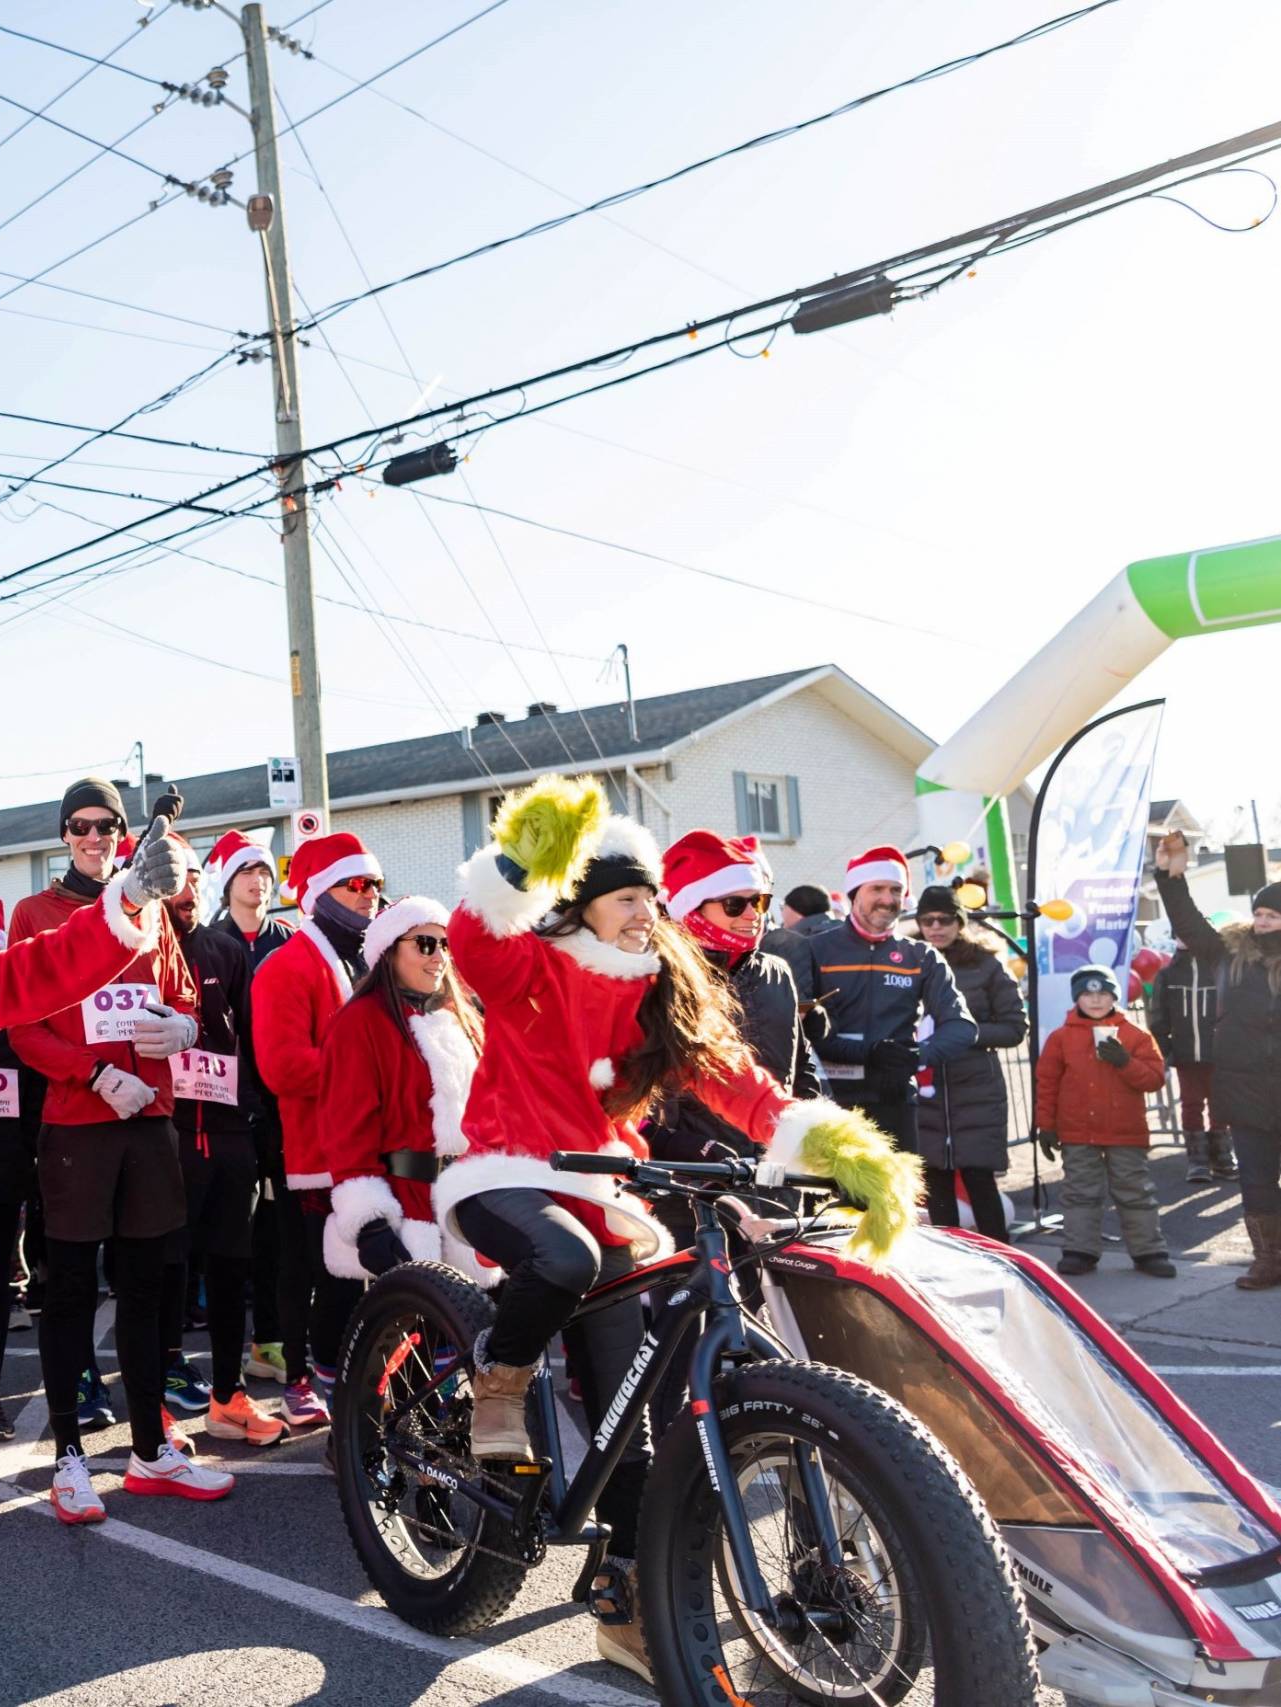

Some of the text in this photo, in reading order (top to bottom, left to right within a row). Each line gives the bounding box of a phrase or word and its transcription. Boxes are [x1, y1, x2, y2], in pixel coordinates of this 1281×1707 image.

[94, 989, 148, 1011] 037
[768, 1256, 819, 1271] Chariot Cougar
[743, 1400, 795, 1415] FATTY
[696, 1420, 721, 1492] SNOWBEAST
[426, 1466, 458, 1490] DAMCO
